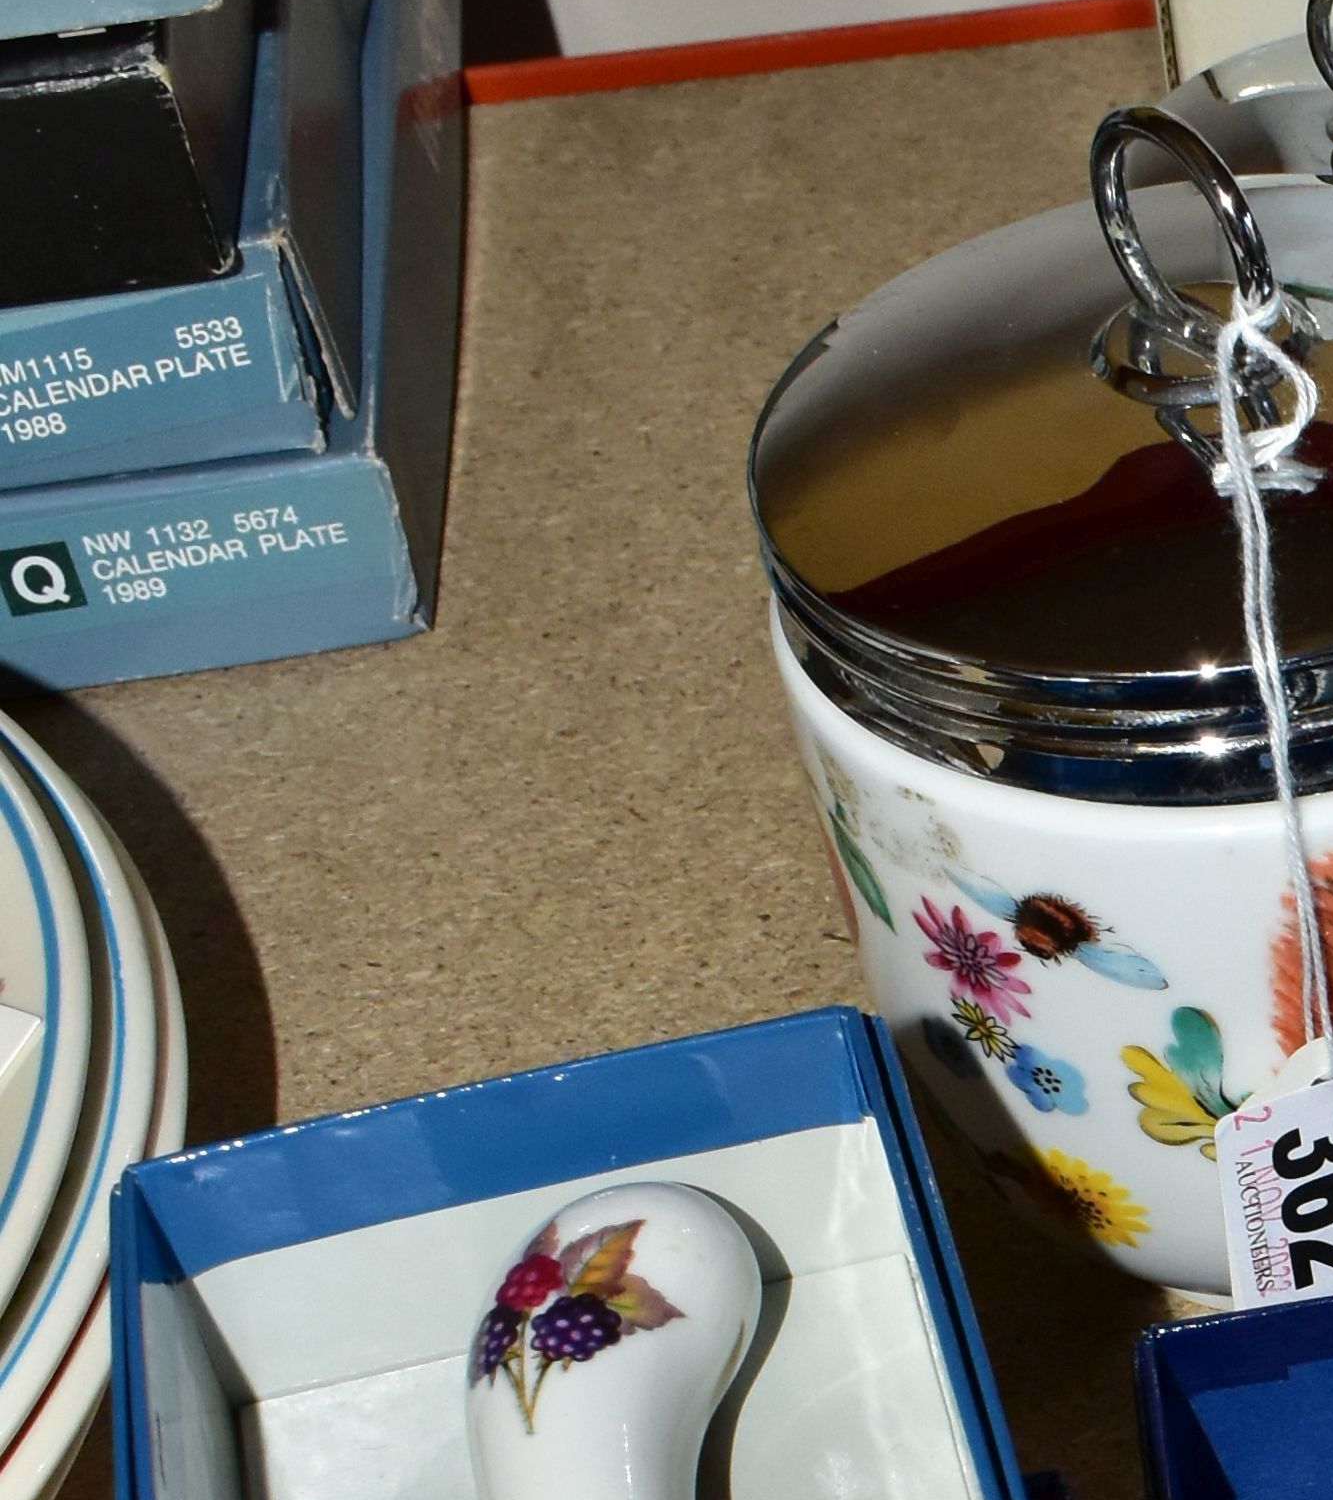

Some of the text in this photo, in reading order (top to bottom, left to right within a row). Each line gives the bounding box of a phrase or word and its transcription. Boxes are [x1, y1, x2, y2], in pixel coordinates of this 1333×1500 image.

[0, 316, 243, 389] M1115 5533
[155, 343, 252, 382] PLATE
[1, 412, 67, 444] 1988
[82, 505, 299, 556] NW 1132 5674
[92, 522, 349, 581] CALENDAR PLATE
[10, 555, 72, 604] Q
[102, 577, 168, 605] 1989
[1235, 1161, 1275, 1292] AUCTIONEERS
